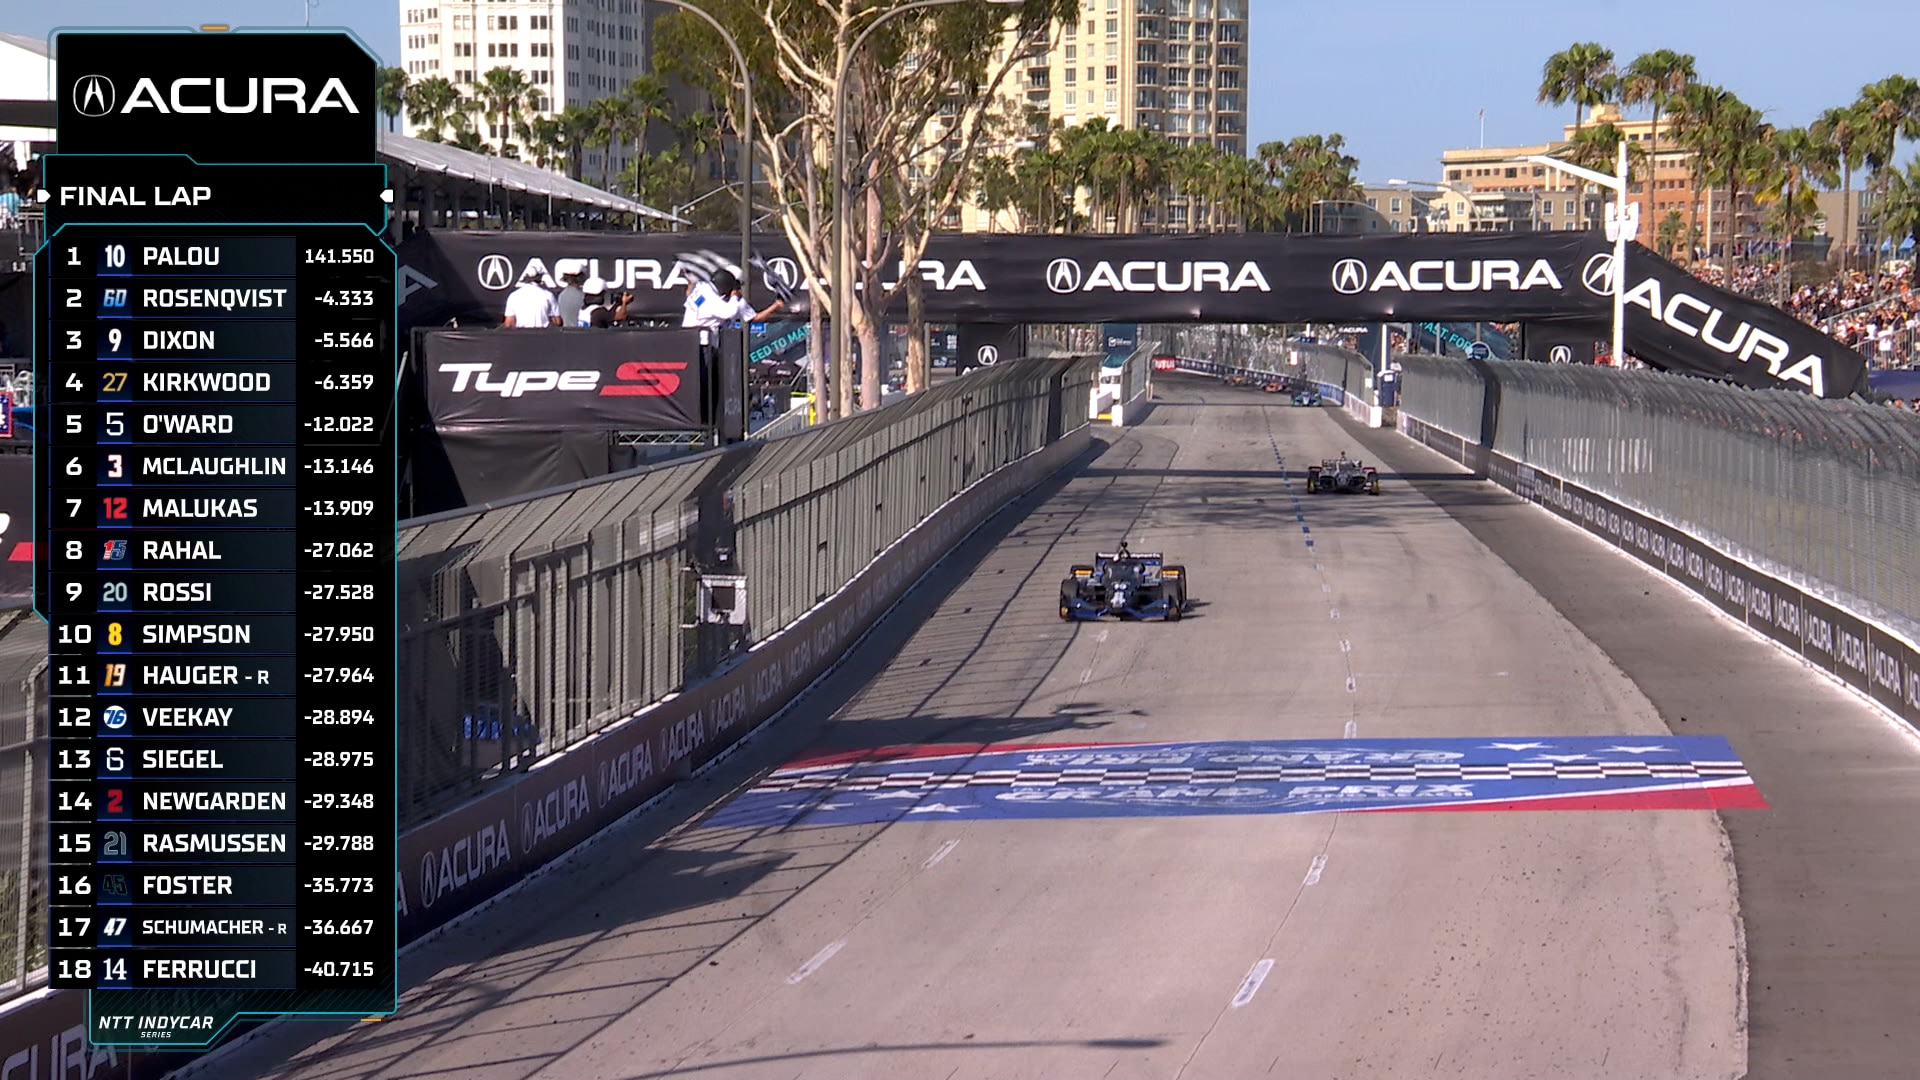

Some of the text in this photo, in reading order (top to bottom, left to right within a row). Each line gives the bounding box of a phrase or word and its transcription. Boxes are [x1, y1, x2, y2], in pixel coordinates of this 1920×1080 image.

[1083, 261, 1271, 292] ACURA
[1369, 259, 1563, 291] ACURA
[750, 345, 772, 362] EED
[771, 336, 787, 350] TO
[1623, 277, 1824, 398] ACURA
[438, 362, 688, 397] Type S
[668, 710, 704, 762] ACURA
[608, 739, 653, 800] ACURA
[534, 775, 590, 845] ACURA
[437, 819, 511, 898] ACURA
